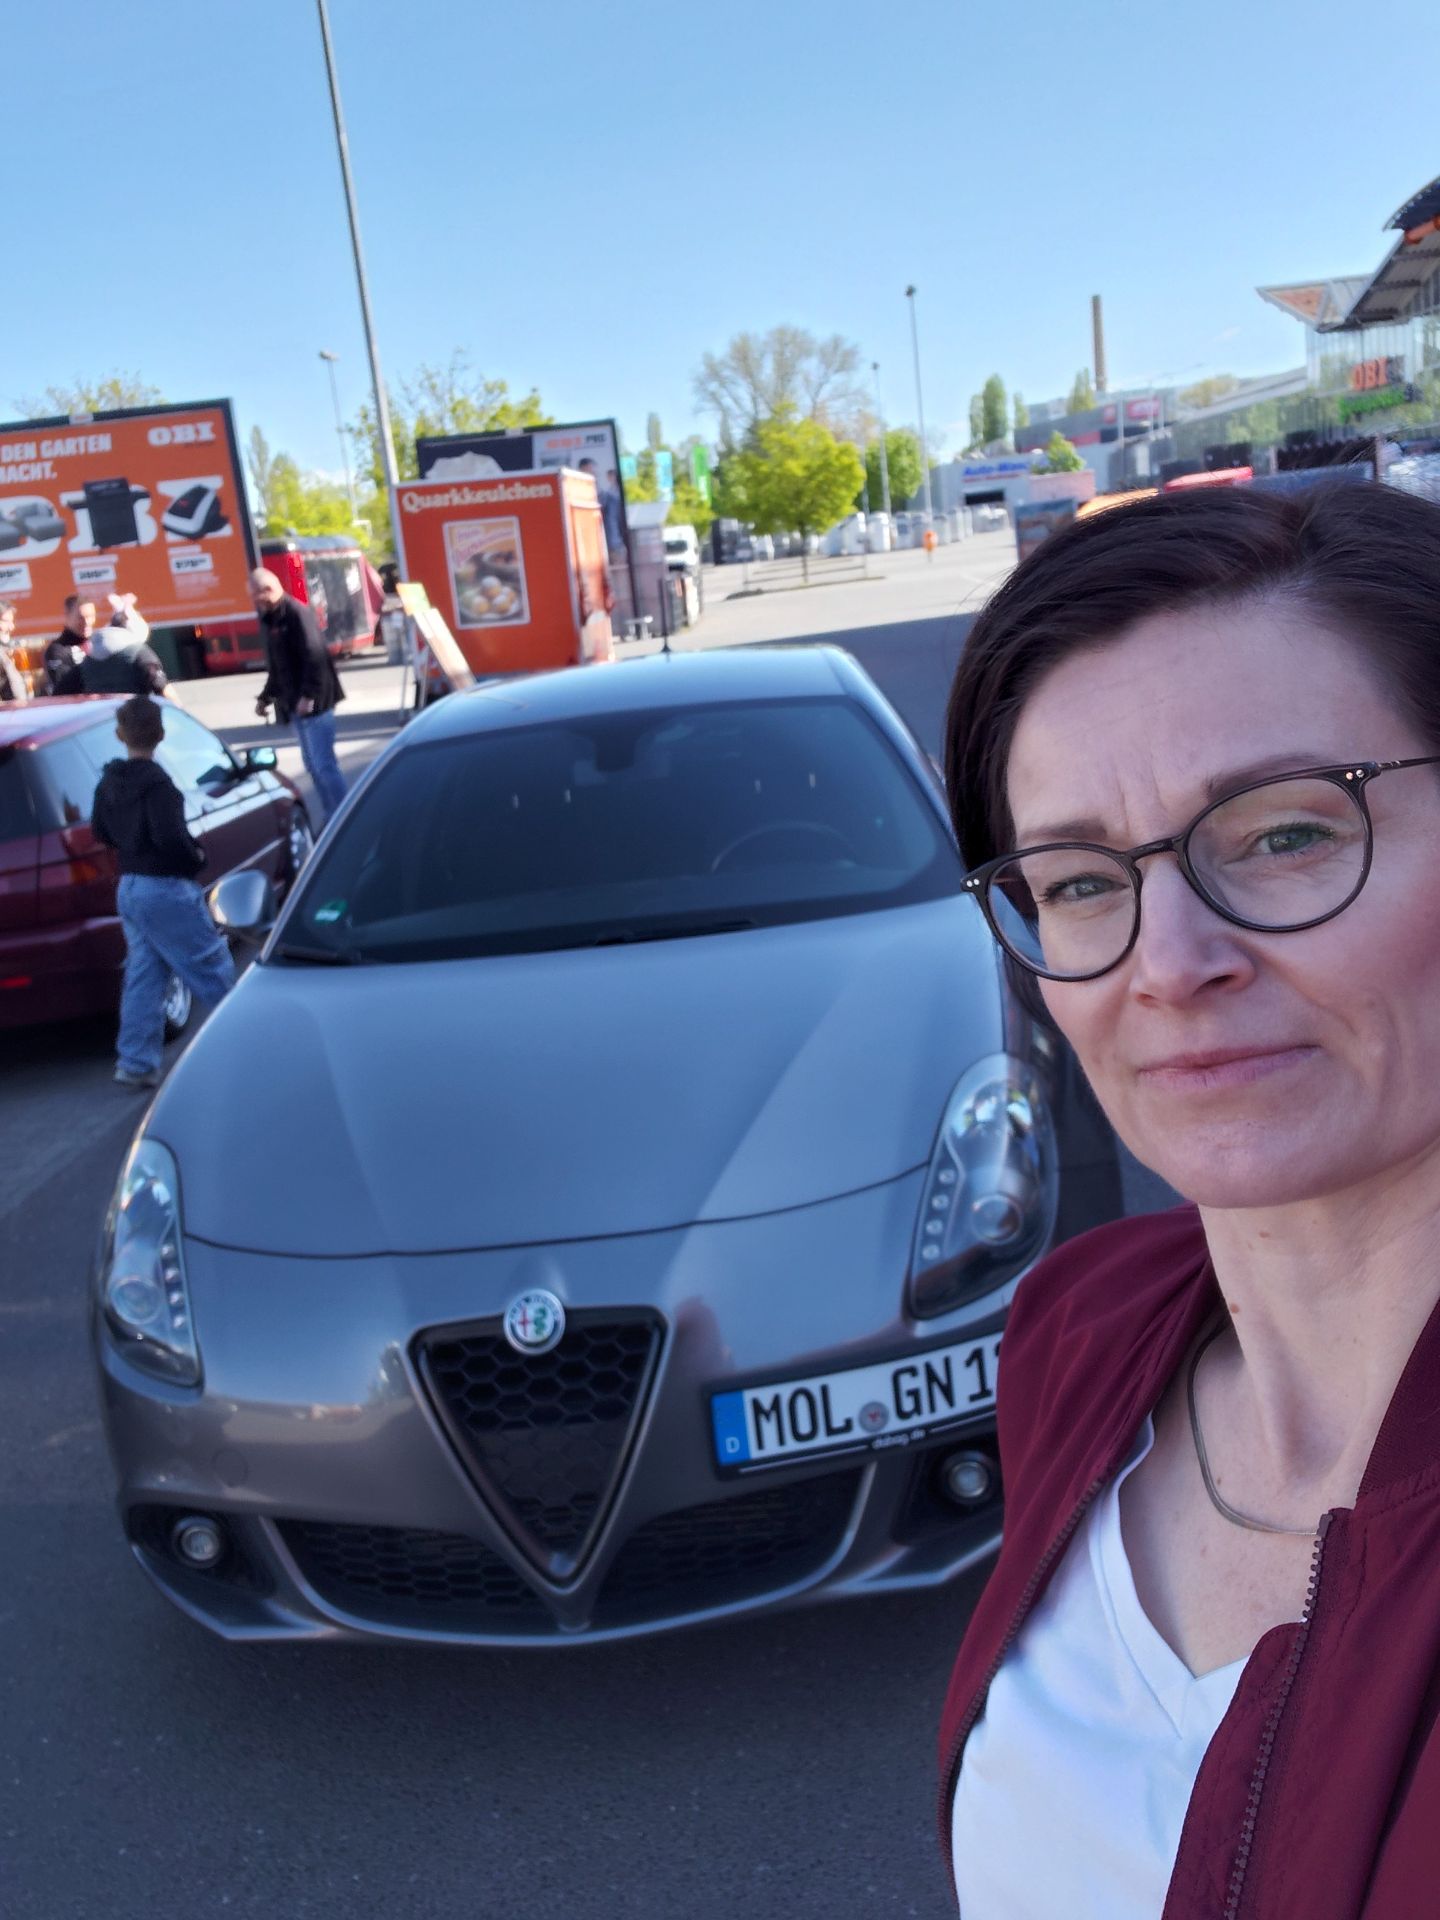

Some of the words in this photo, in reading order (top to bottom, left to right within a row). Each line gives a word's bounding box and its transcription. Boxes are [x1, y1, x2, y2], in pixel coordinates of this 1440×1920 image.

[1353, 356, 1389, 391] OBI
[41, 432, 113, 458] GARTEN
[147, 421, 216, 446] OBI
[402, 482, 553, 513] Quarkkeulchen
[752, 1384, 853, 1450] MOL
[725, 1436, 741, 1454] D
